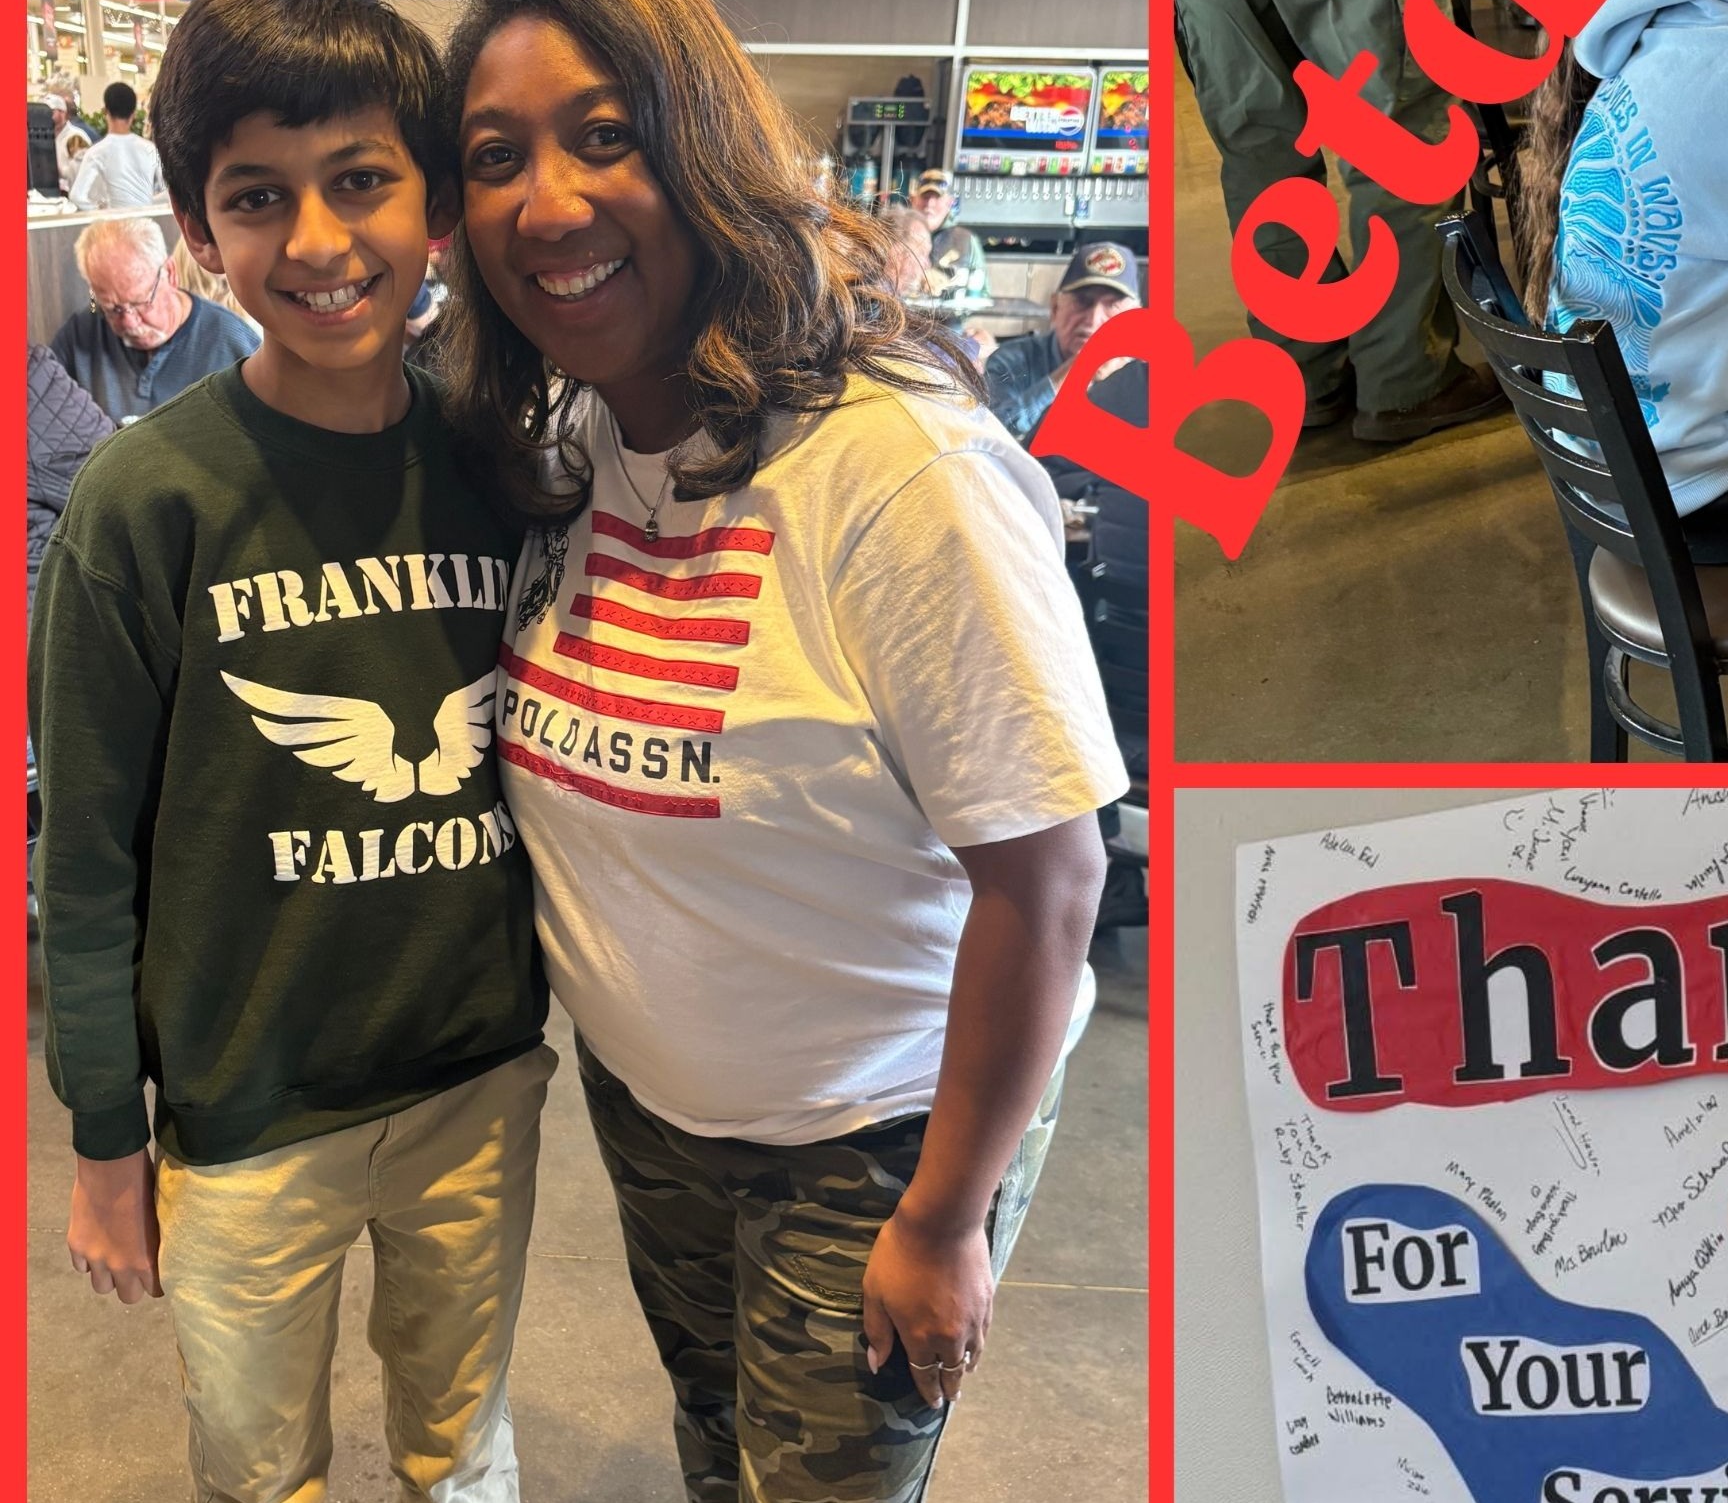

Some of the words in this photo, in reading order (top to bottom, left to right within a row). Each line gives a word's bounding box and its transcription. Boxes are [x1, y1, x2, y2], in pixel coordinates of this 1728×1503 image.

[1625, 126, 1658, 173] IN
[1639, 173, 1684, 282] WAVES
[1347, 1220, 1469, 1296] For
[1465, 1346, 1647, 1412] Your
[1326, 1409, 1387, 1429] Williams
